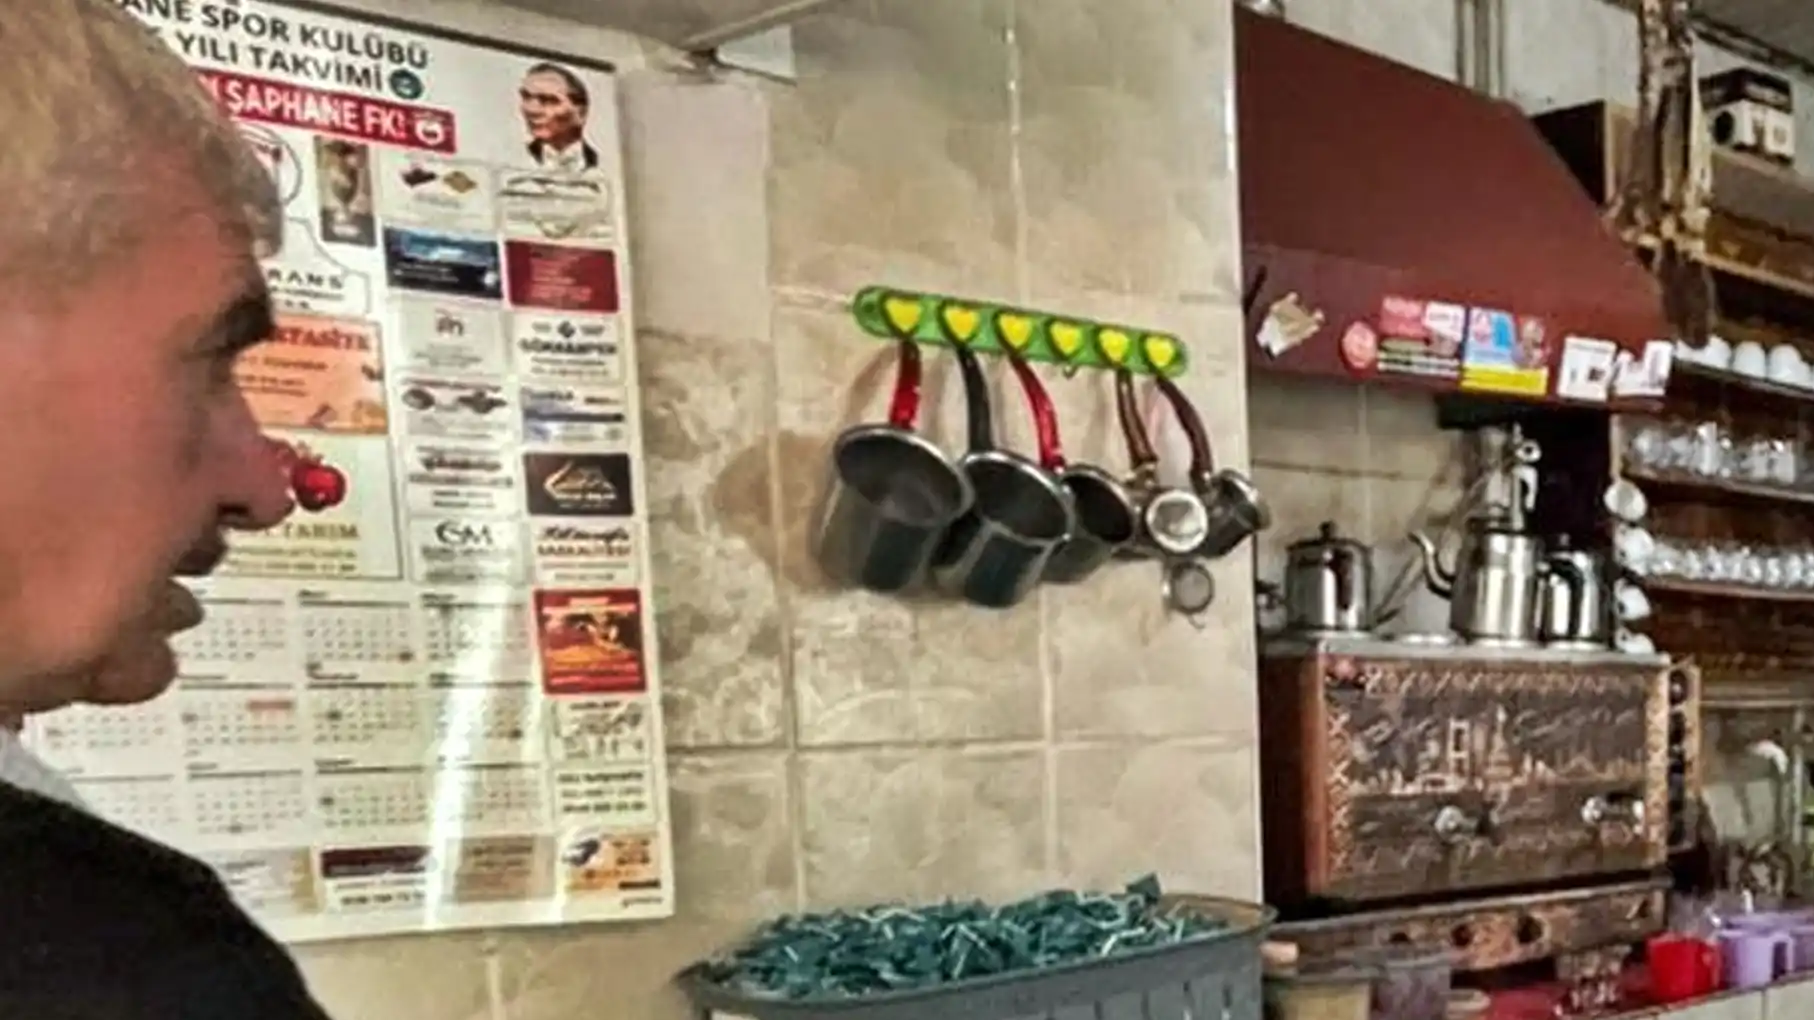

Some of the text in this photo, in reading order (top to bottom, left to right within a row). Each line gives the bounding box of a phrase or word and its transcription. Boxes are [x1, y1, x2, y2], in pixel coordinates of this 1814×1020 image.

[175, 29, 238, 65] YILI
[249, 45, 382, 92] TAKVİMİ
[201, 4, 290, 43] SPOR
[300, 23, 428, 70] KULÜBÜ
